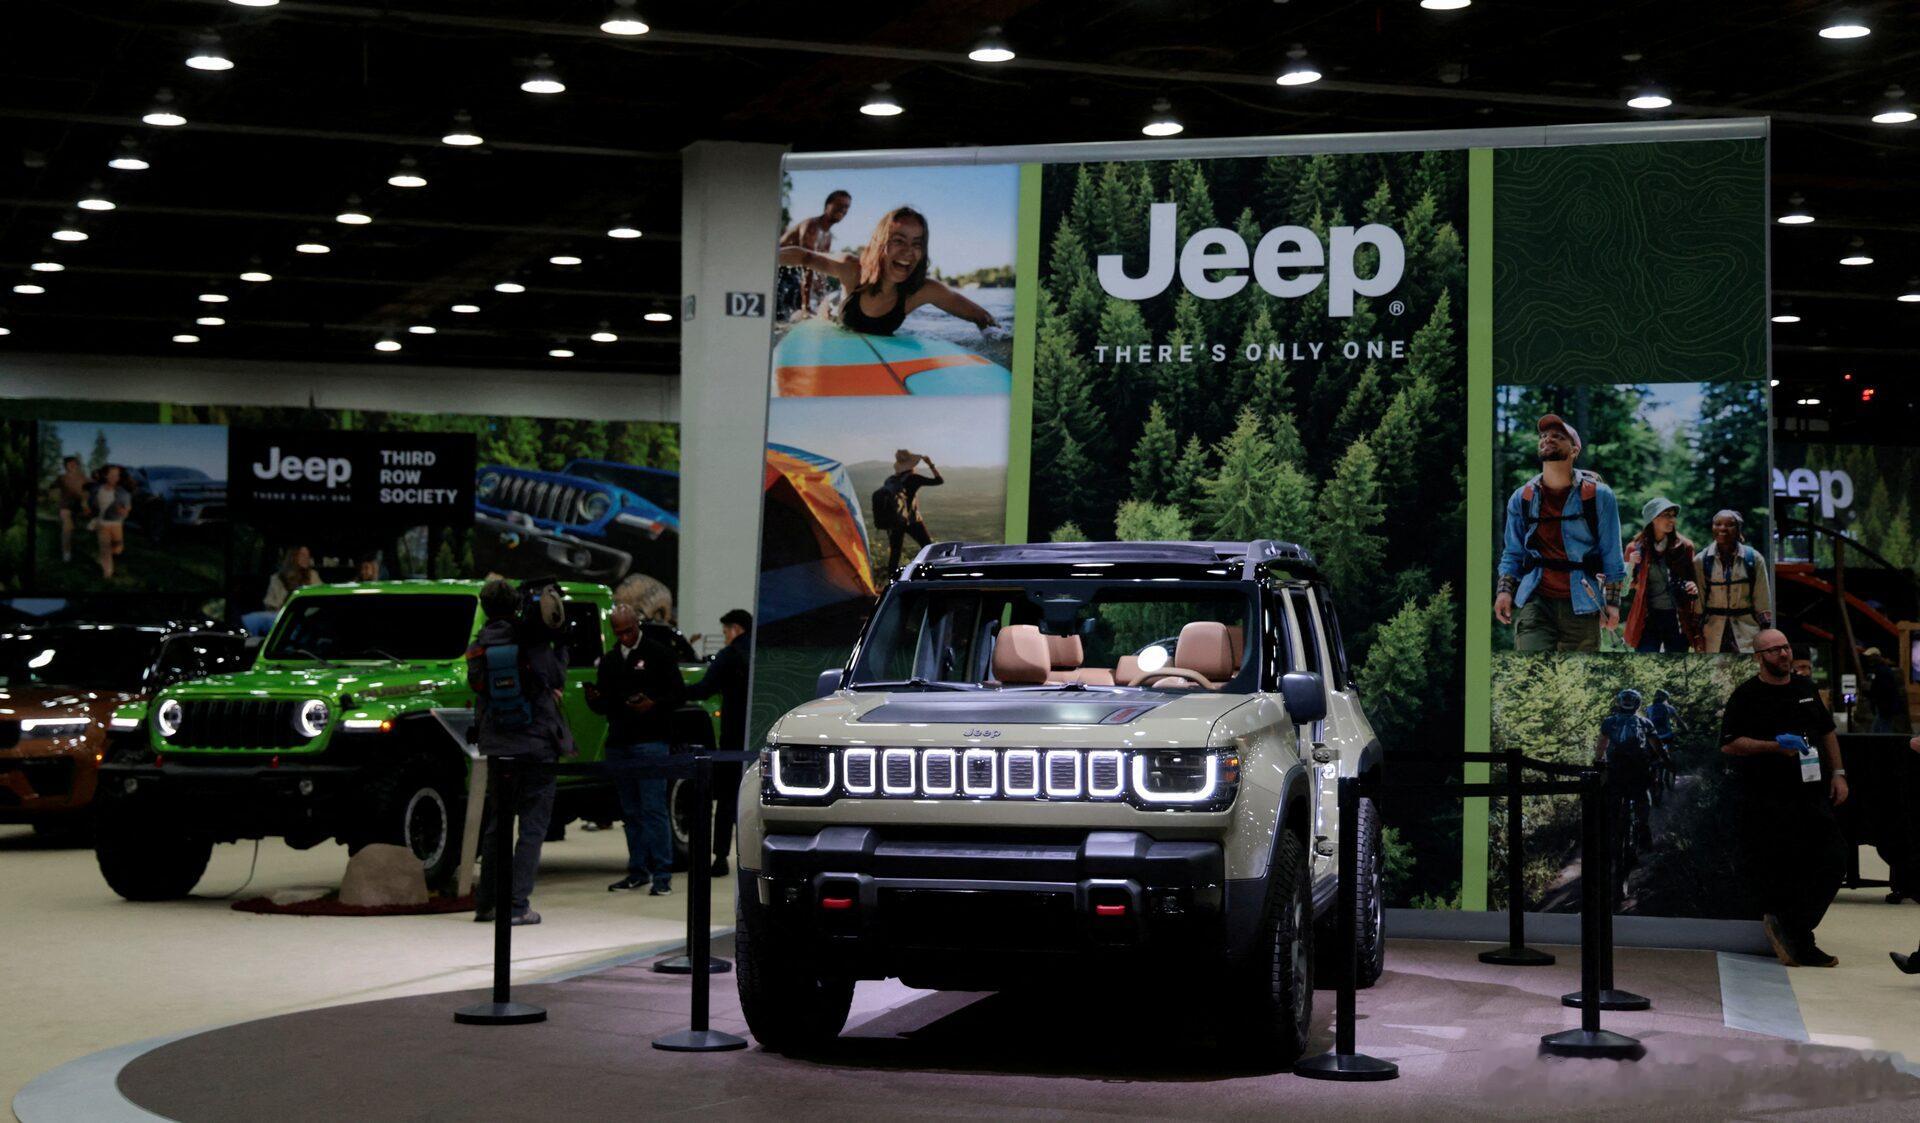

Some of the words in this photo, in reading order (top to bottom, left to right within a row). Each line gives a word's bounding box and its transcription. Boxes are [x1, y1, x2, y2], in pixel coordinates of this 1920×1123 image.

[1097, 203, 1405, 317] Jeep
[731, 293, 760, 317] D2
[1095, 344, 1226, 363] THERE'S
[1246, 342, 1323, 361] ONLY
[1343, 340, 1405, 359] ONE
[253, 446, 352, 488] Jeep
[380, 450, 436, 466] THIRD
[380, 469, 422, 485] ROW
[380, 488, 458, 504] SOCIETY
[962, 727, 1002, 739] Jeep
